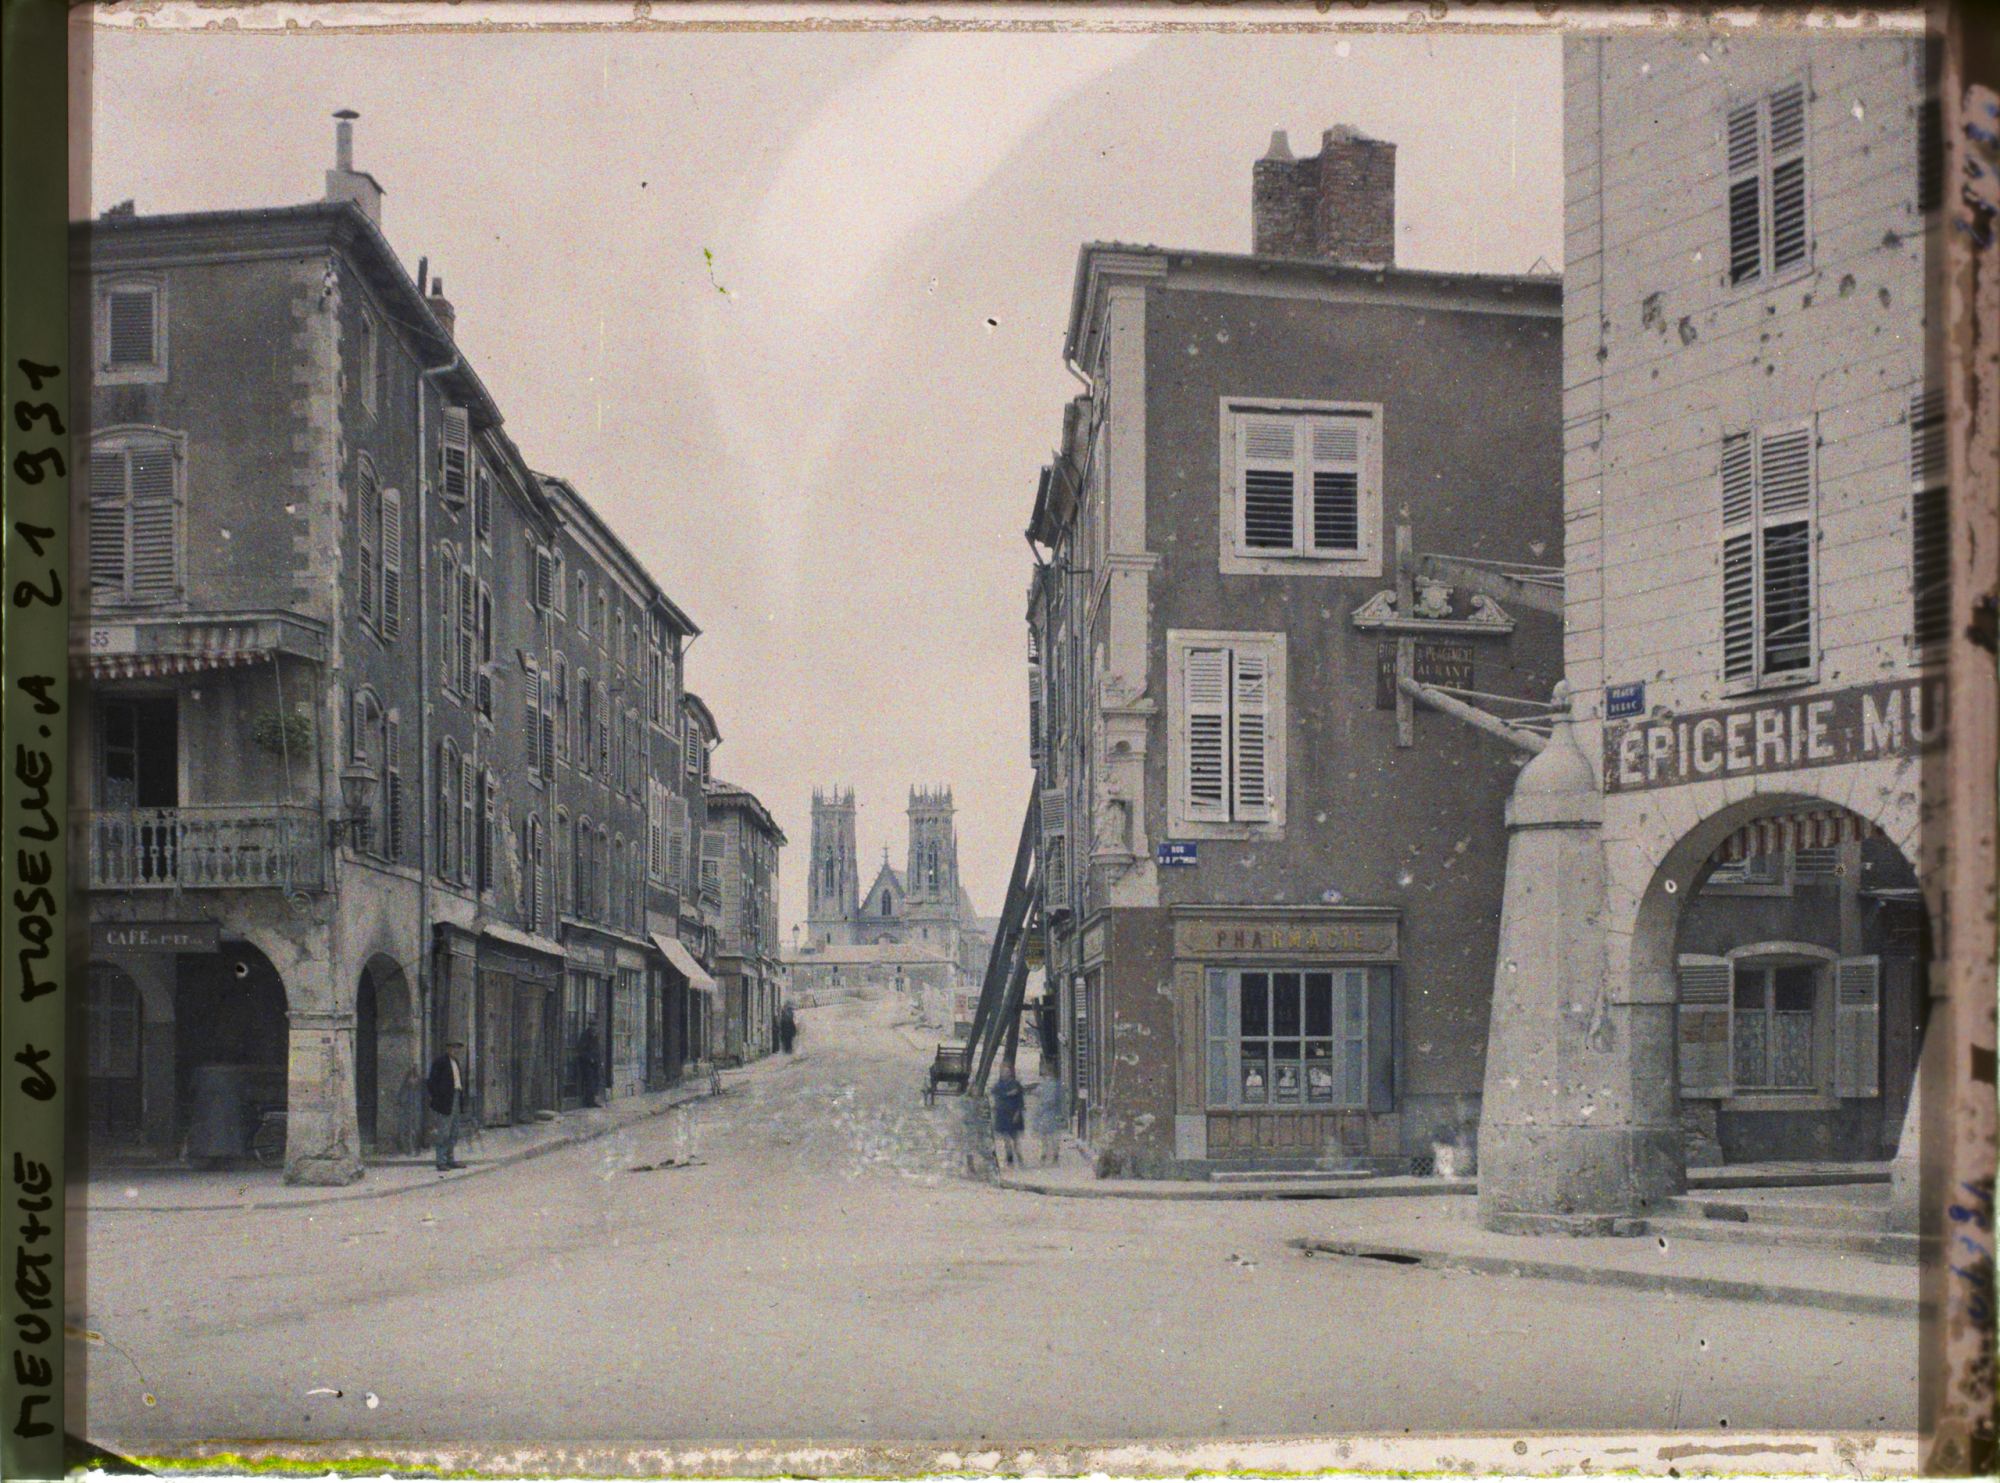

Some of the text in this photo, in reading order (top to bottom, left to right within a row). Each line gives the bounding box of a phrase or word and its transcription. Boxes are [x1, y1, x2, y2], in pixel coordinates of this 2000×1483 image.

[12, 358, 61, 486] 931
[1619, 699, 1834, 785] EPICERIE
[1216, 929, 1363, 949] PHARMACIE
[14, 1043, 57, 1101] et
